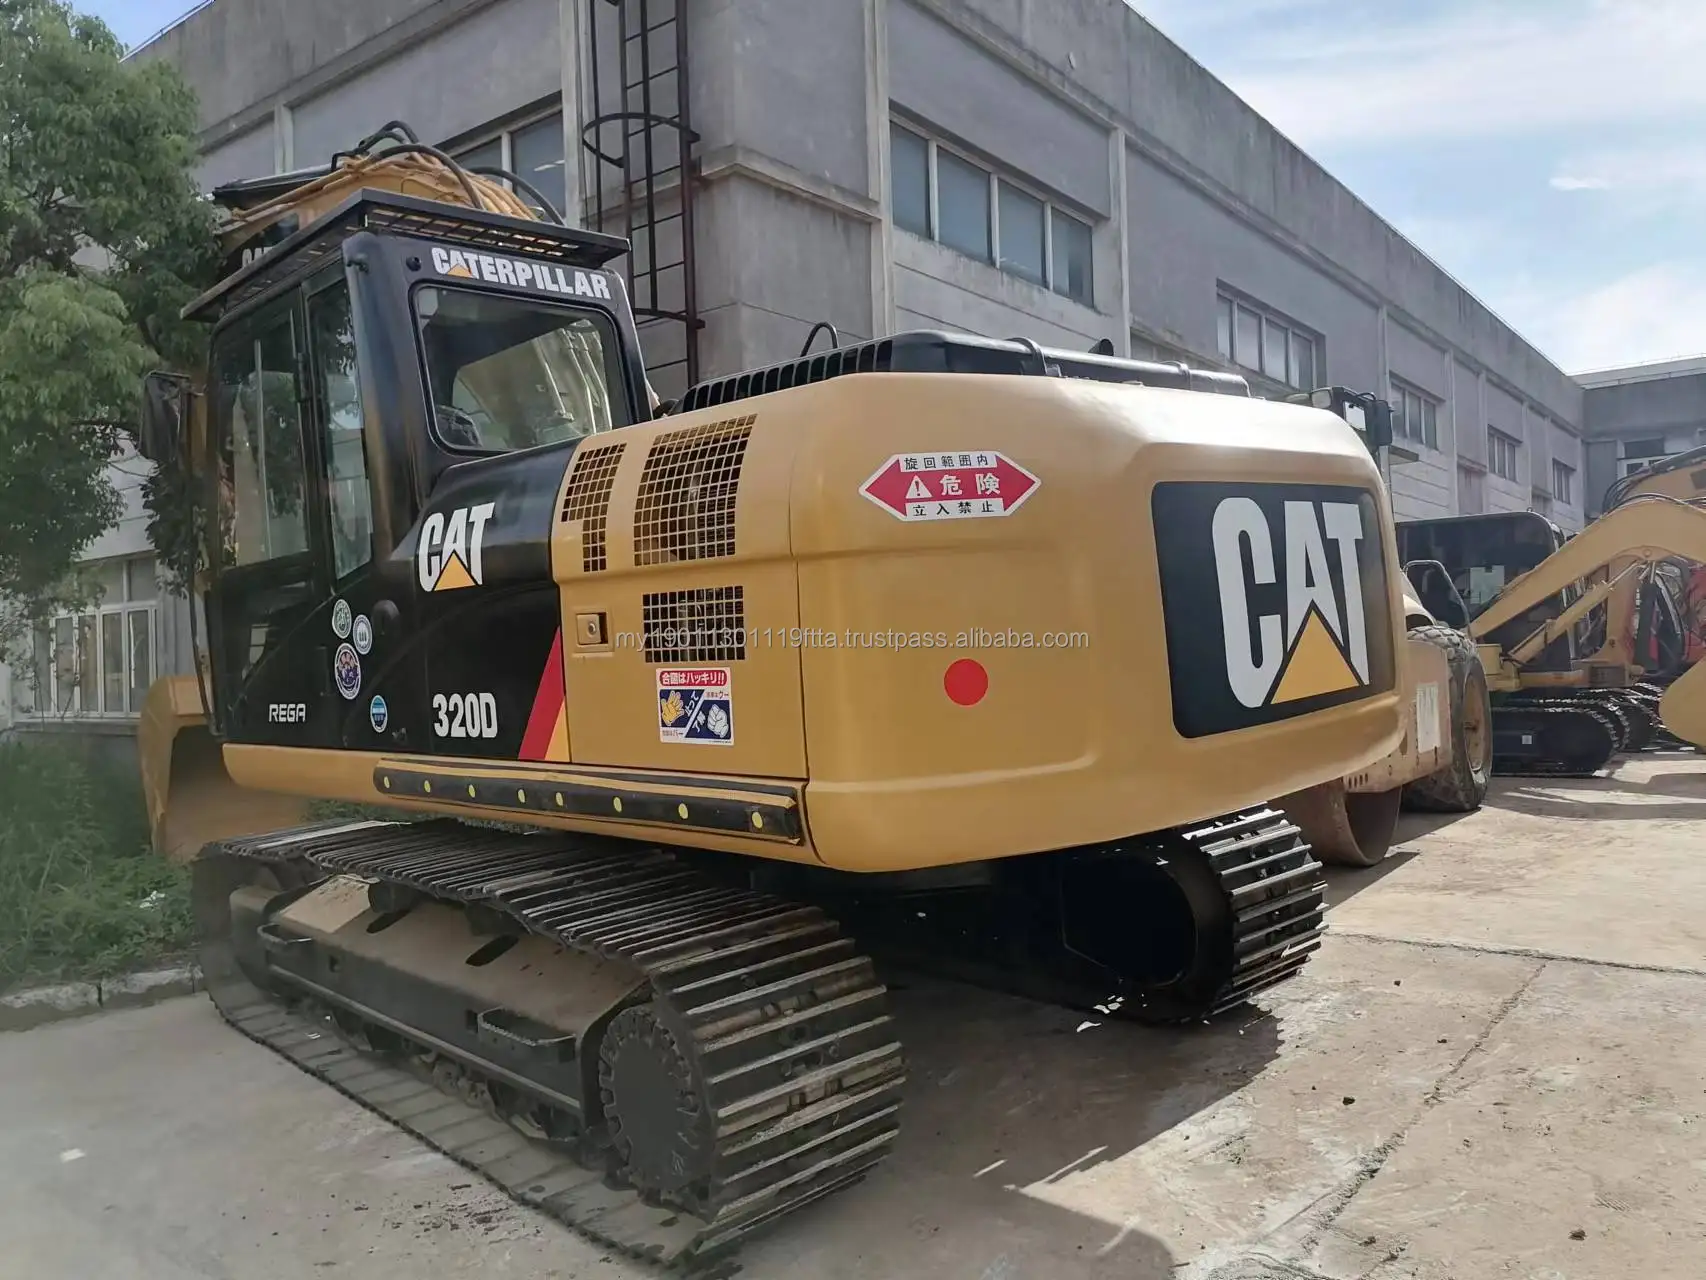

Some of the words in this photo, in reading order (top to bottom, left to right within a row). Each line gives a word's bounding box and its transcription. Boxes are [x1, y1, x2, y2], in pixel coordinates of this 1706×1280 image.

[431, 247, 611, 299] CATERPILLAR
[904, 454, 988, 471] 旋回範囲内
[940, 473, 1000, 496] 危険
[913, 501, 994, 516] 立入禁止
[418, 502, 495, 592] CAT
[1212, 497, 1369, 708] CAT
[269, 703, 306, 722] REGA
[432, 692, 497, 738] 320D
